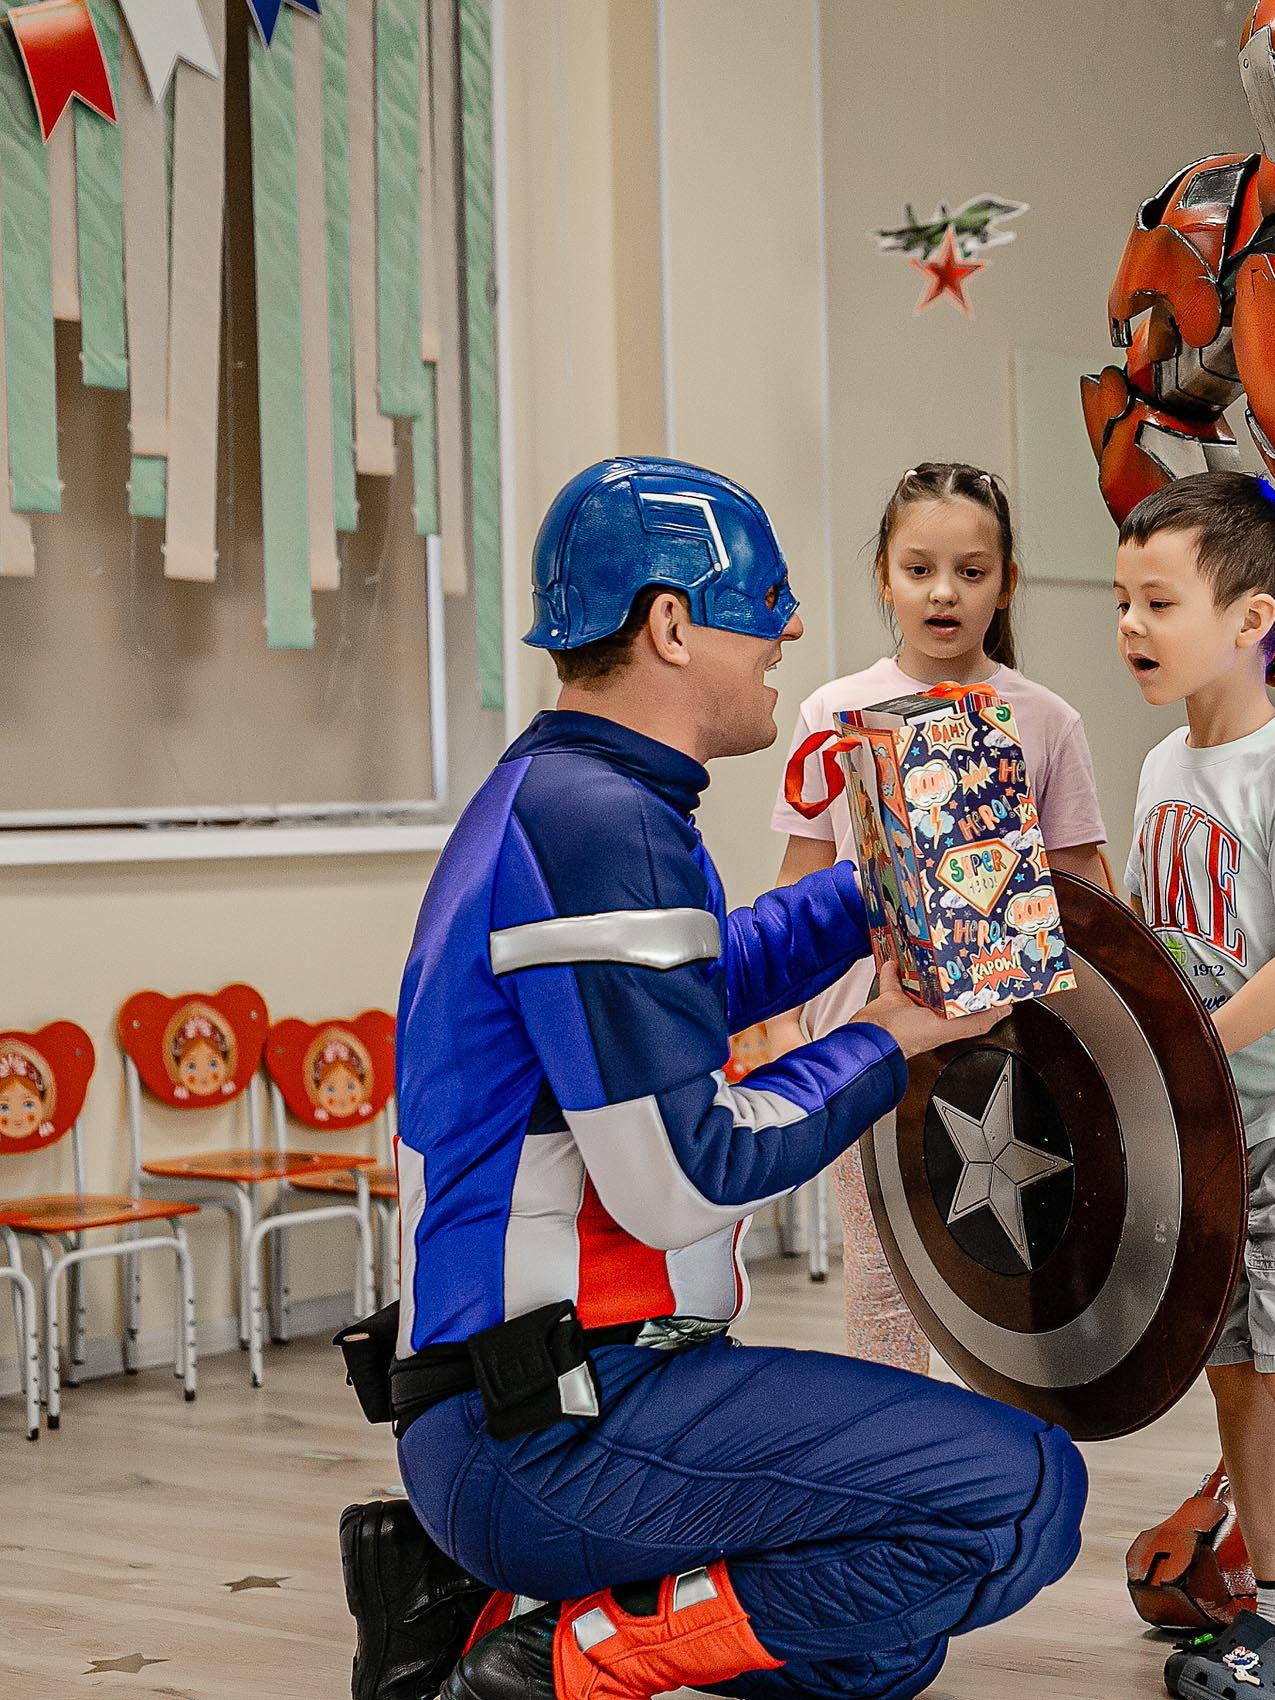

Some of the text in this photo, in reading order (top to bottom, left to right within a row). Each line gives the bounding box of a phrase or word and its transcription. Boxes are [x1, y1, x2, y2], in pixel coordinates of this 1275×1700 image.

[931, 722, 965, 743] BAM!
[910, 770, 951, 798] BOOM
[971, 951, 1022, 984] KAPOW!
[1193, 963, 1226, 977] 1972
